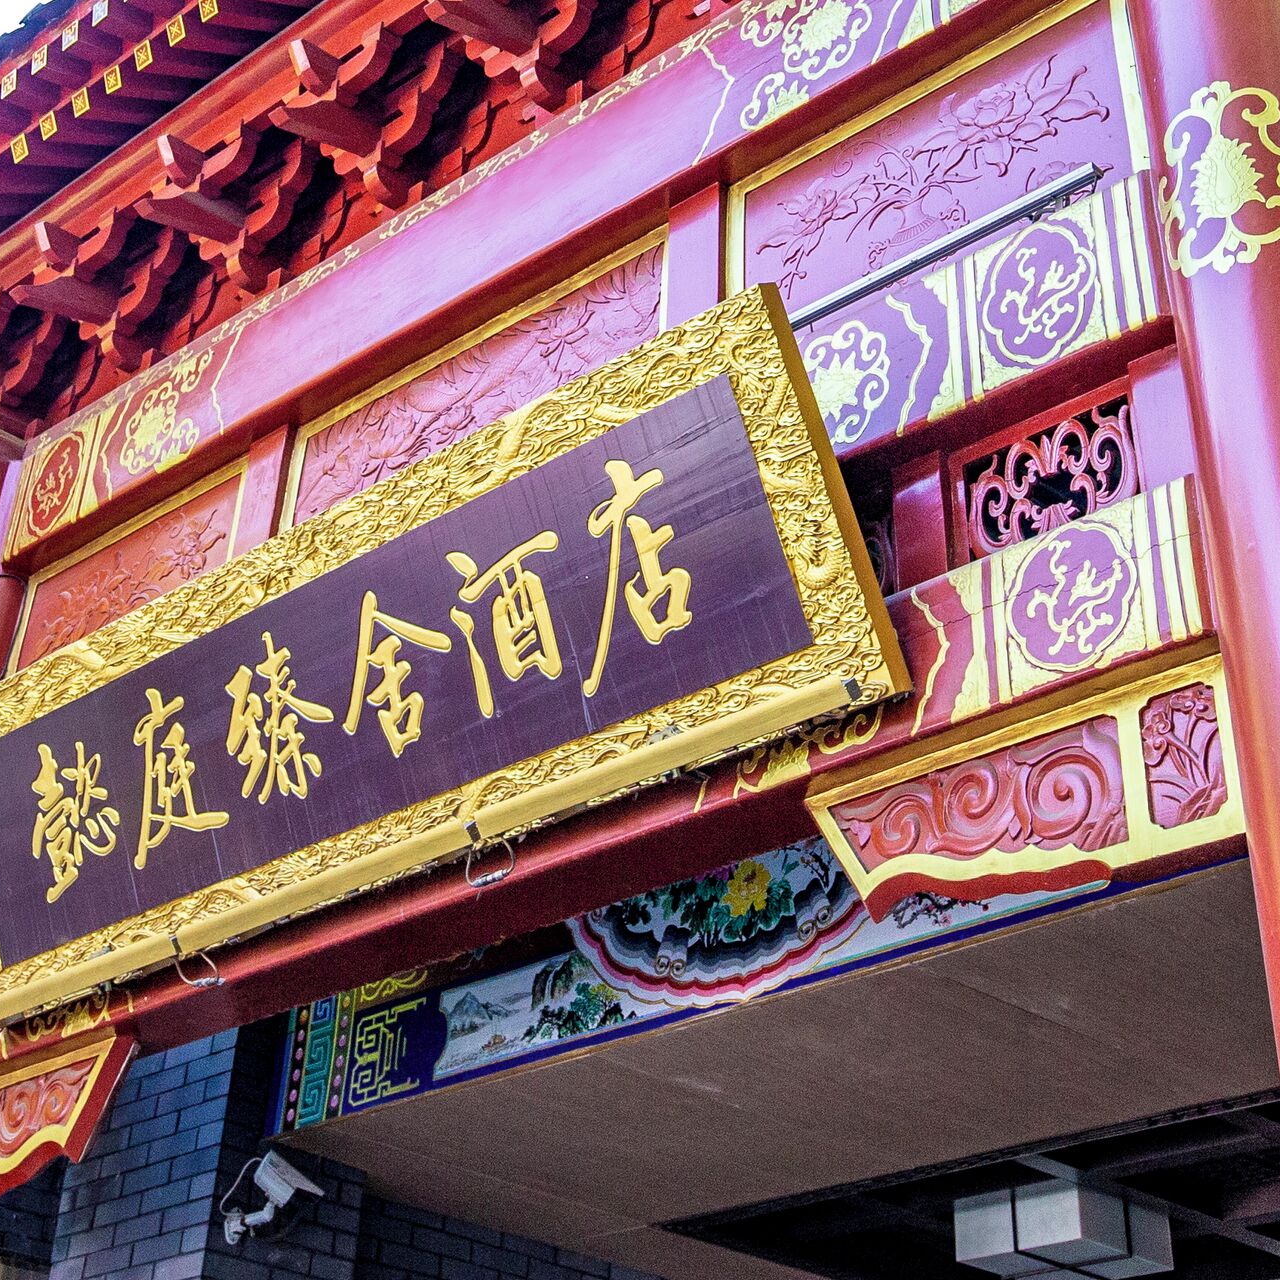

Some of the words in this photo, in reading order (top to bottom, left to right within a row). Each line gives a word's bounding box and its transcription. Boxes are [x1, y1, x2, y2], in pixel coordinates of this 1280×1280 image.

[32, 459, 693, 903] 懿庭臻舍酒店
